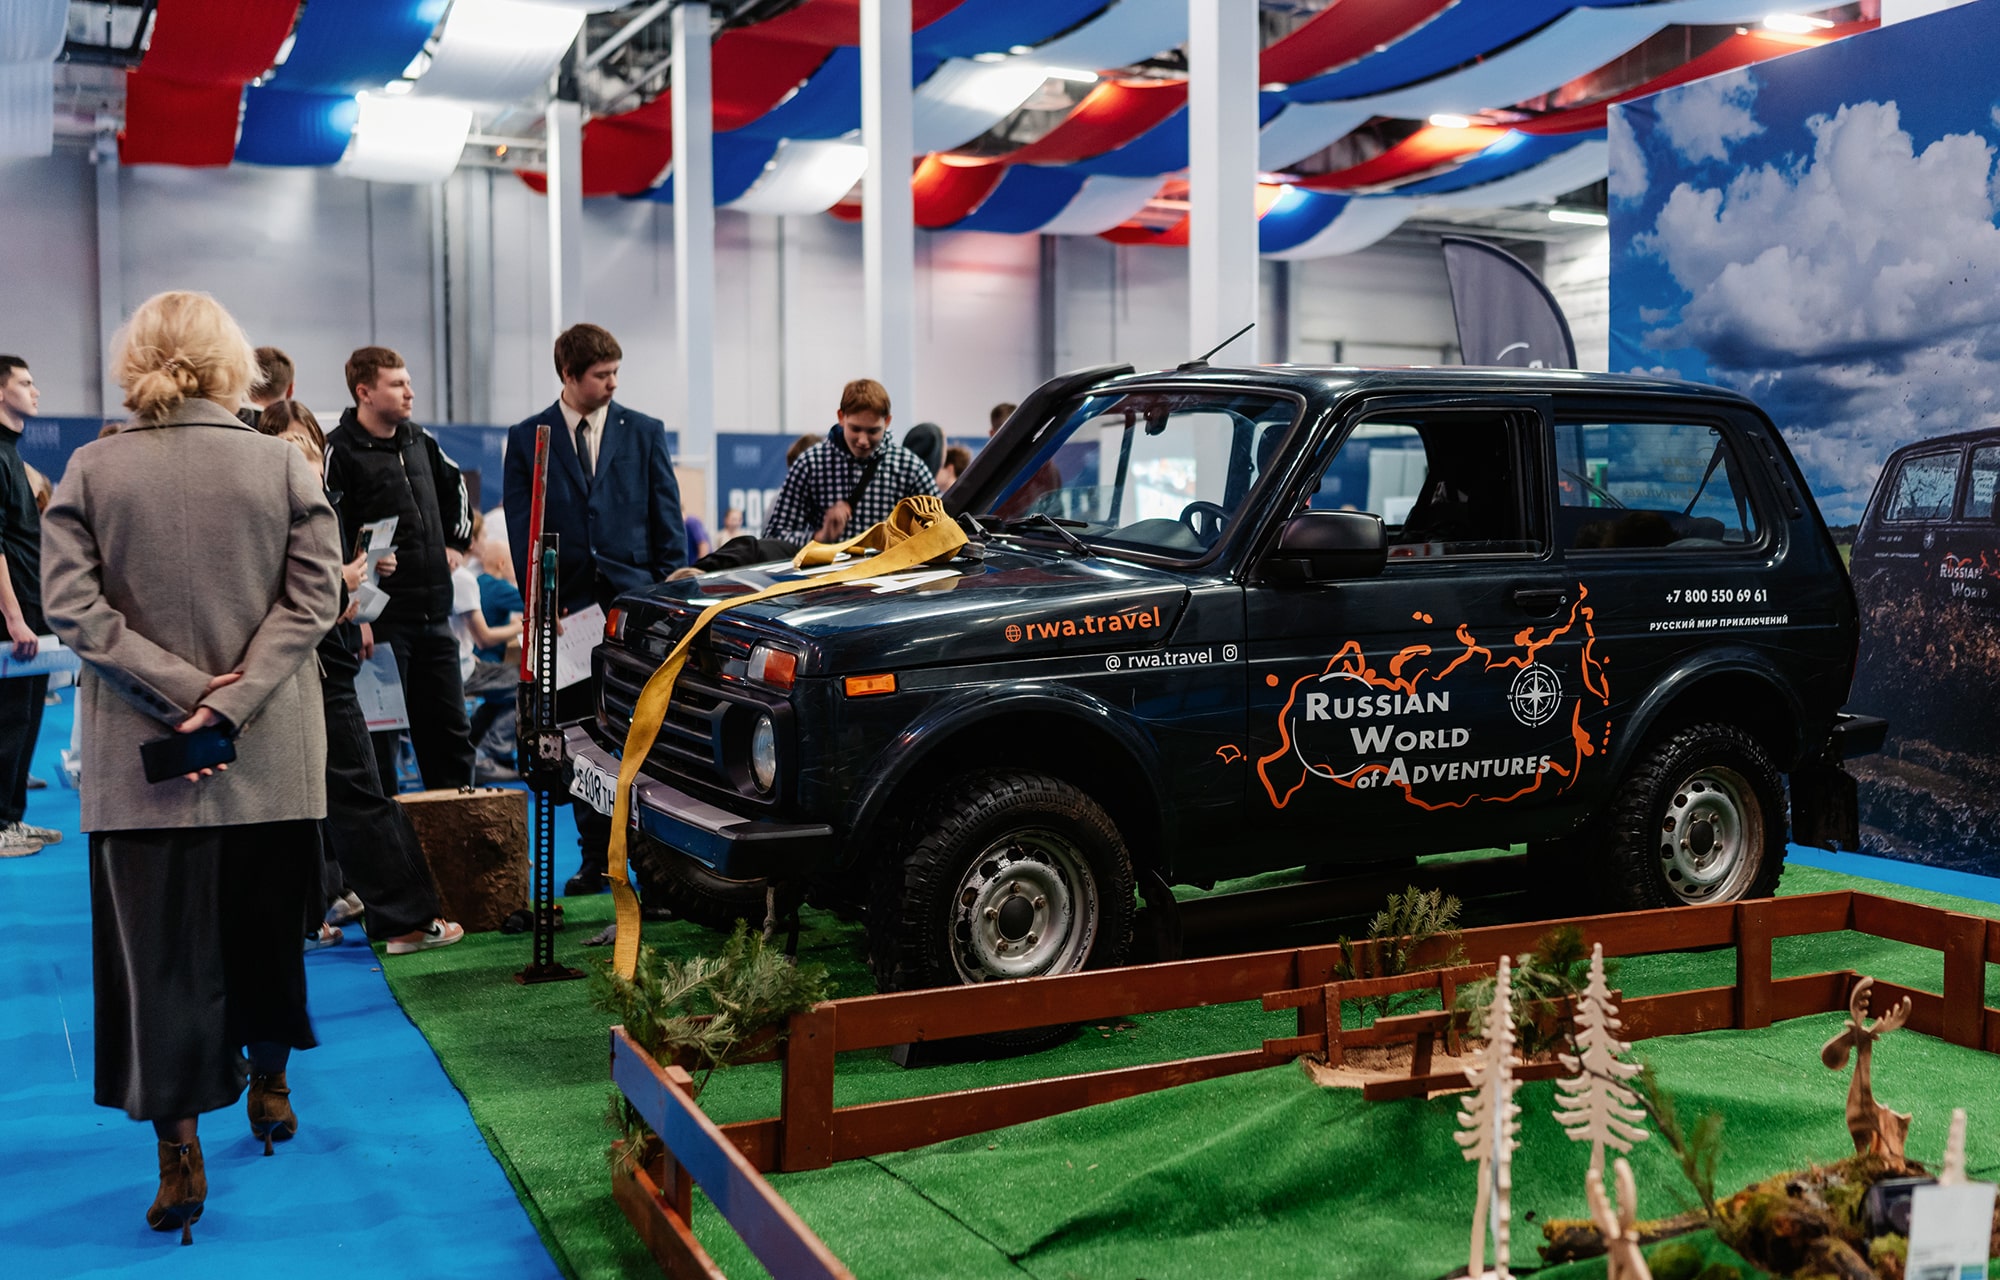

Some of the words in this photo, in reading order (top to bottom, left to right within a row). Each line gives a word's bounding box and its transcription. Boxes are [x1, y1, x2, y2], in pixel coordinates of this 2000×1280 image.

[1665, 589, 1681, 603] +7
[1684, 589, 1708, 603] 800
[1711, 589, 1734, 603] 550
[1736, 589, 1751, 602] 69
[1754, 589, 1767, 602] 61
[1025, 606, 1161, 641] rwa.travel
[1649, 618, 1695, 631] РУССКИЙ
[1696, 618, 1718, 629] МИР
[1719, 614, 1789, 627] ПРИКЛЮЧЕНИЙ
[1127, 648, 1213, 669] rwa.travel
[1306, 691, 1450, 721] RUSSIAN
[1350, 725, 1470, 755] WORLD
[1356, 769, 1380, 790] of
[1382, 755, 1551, 787] ADVENTURES
